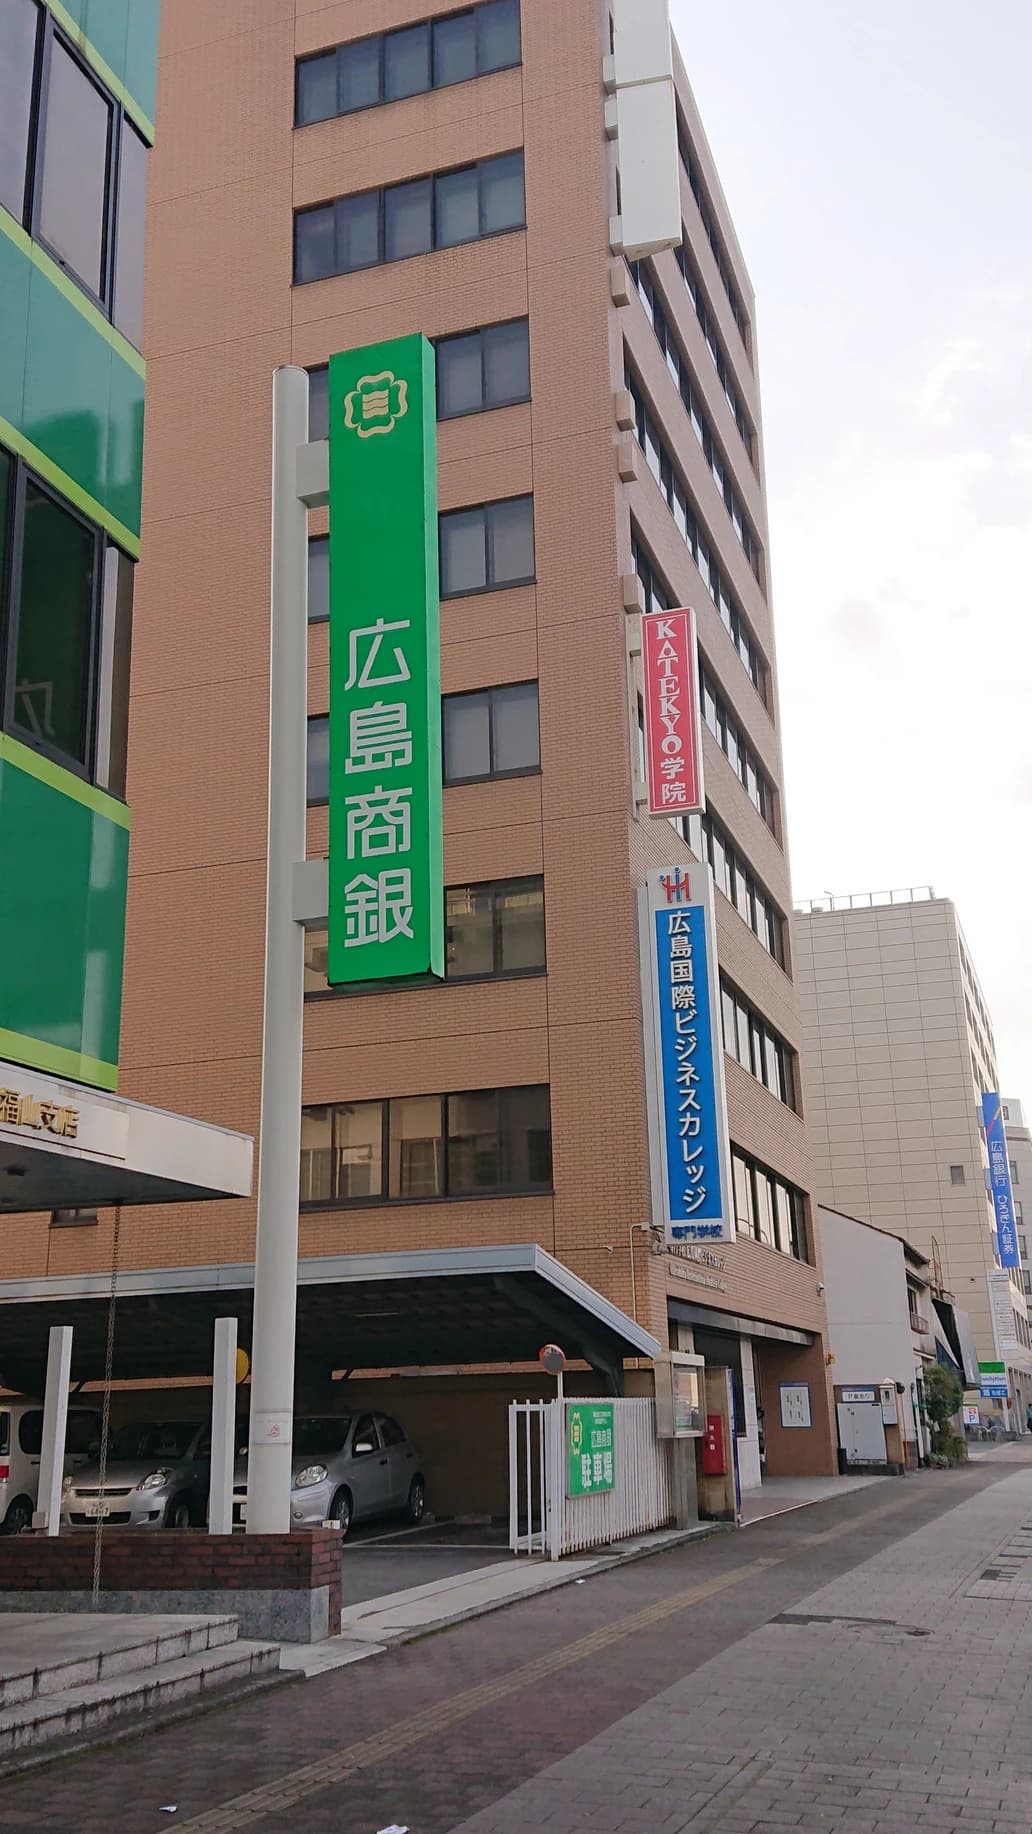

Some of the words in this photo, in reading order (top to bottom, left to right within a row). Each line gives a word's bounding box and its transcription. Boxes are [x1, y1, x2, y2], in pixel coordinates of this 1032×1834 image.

[656, 619, 687, 805] KATEKYO学院
[344, 617, 415, 950] 広島商銀
[667, 910, 708, 1214] 広島国際ビジネスカレッジ
[0, 1088, 79, 1138] 福山支店
[991, 1140, 1008, 1187] 広島銀行
[672, 1224, 723, 1240] 専門学校
[997, 1195, 1015, 1255] ひろぎん証券
[581, 1451, 613, 1488] 駐車場
